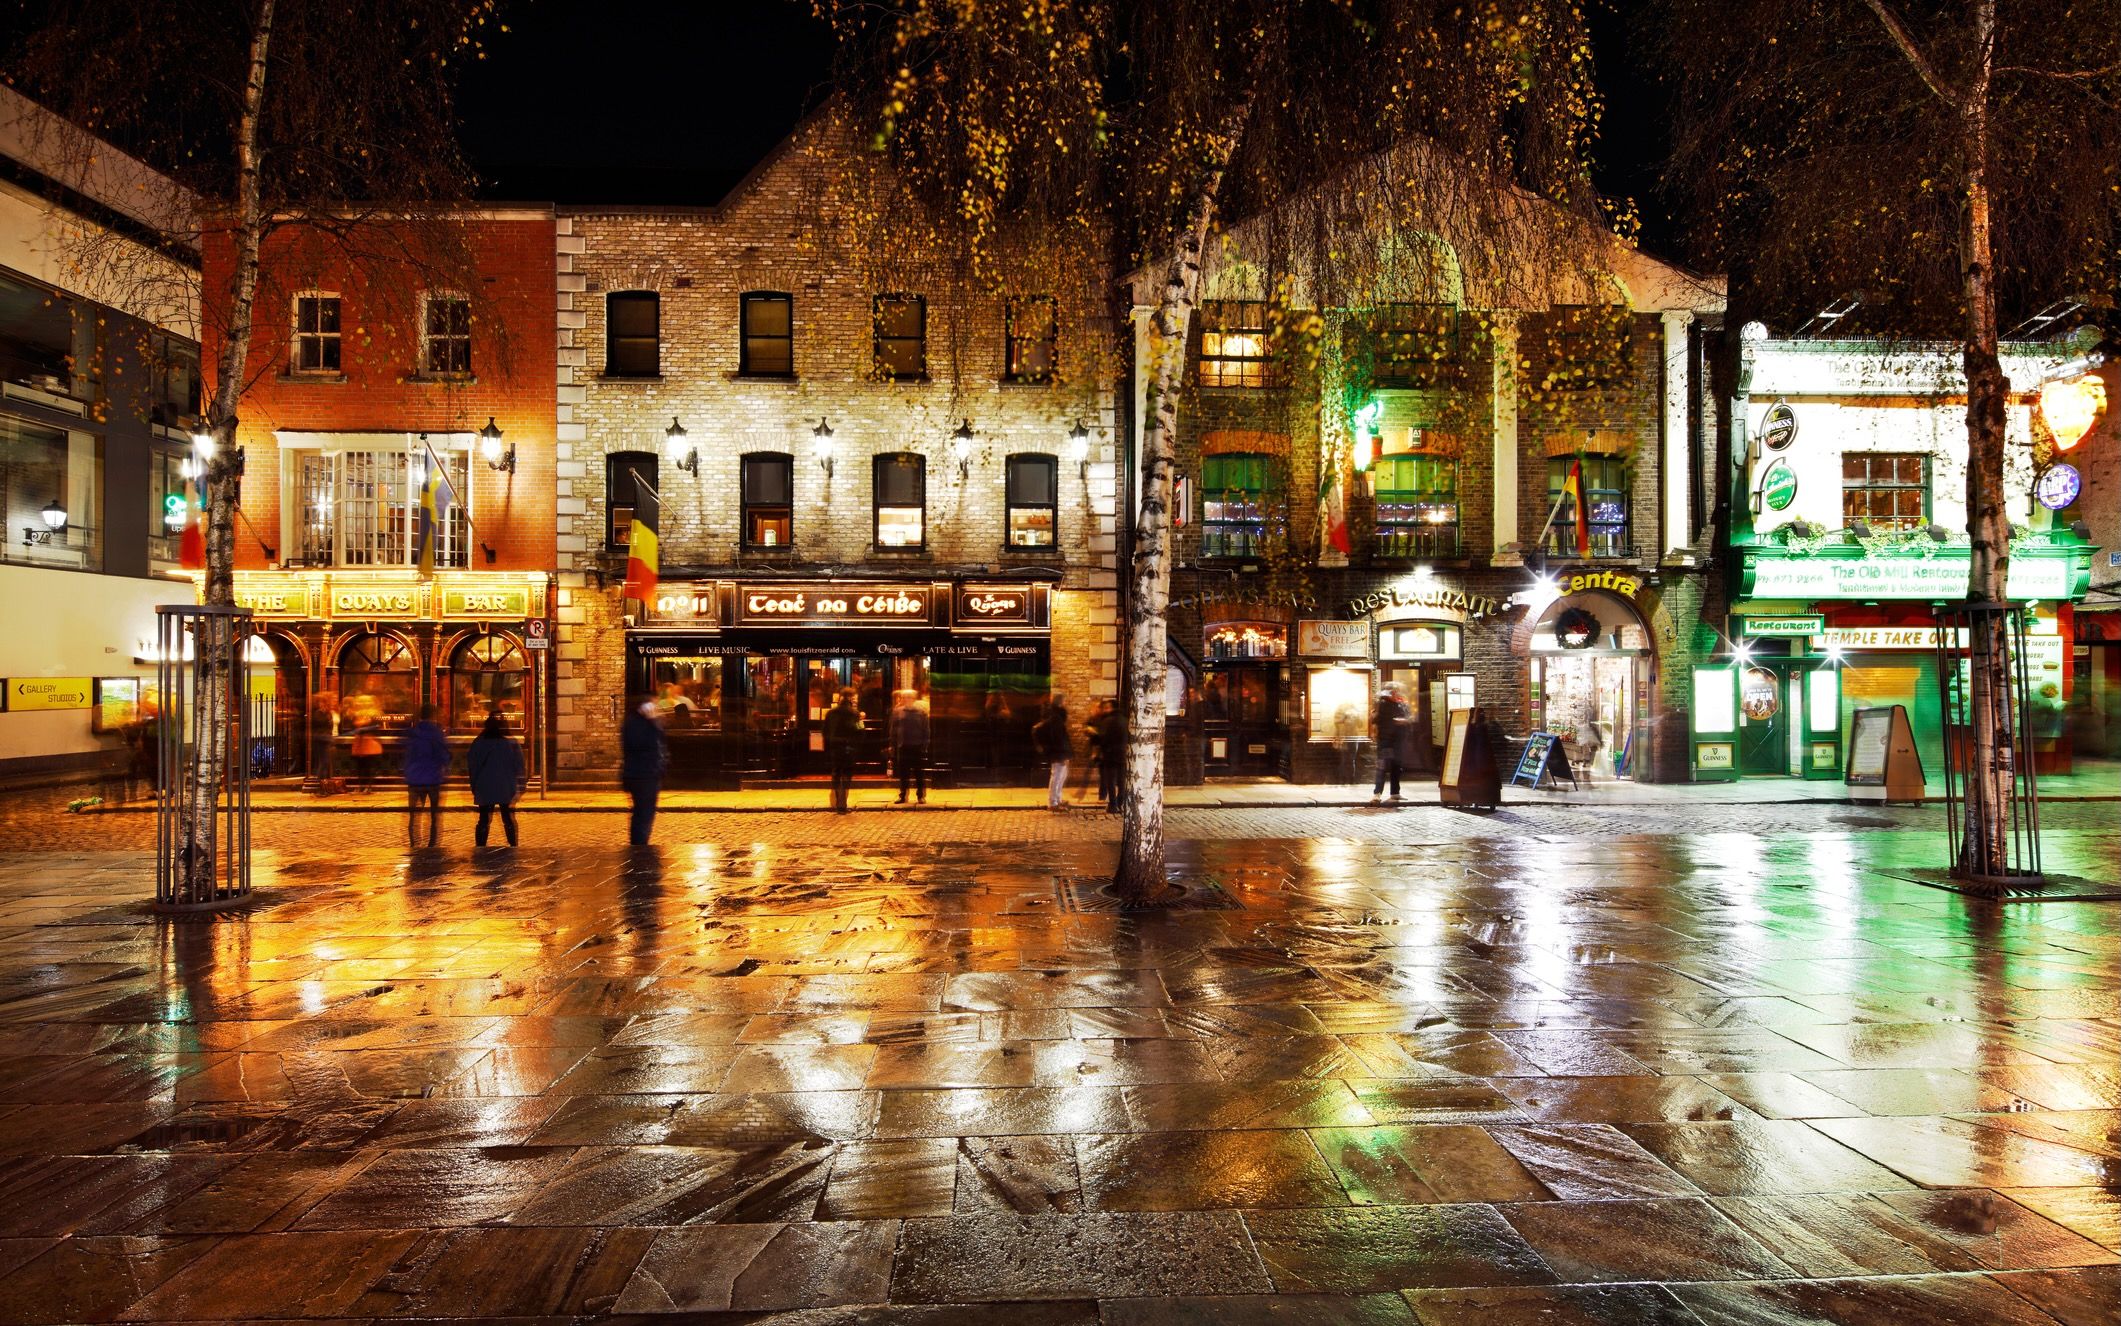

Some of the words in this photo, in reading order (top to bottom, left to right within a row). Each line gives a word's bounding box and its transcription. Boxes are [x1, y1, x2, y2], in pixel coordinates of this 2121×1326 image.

[1830, 565, 1855, 579] The
[1556, 570, 1637, 598] Centra
[243, 594, 287, 611] THE
[463, 594, 507, 611] BAR
[1317, 623, 1347, 637] QUAYS
[1349, 625, 1366, 635] BAR
[1749, 620, 1817, 631] Restaurant
[1330, 636, 1349, 645] FREE
[1823, 632, 1877, 645] TEMPLE
[1885, 632, 1922, 645] TAKE
[646, 646, 679, 654] GUINNESS
[698, 646, 720, 654] LIVE
[721, 646, 750, 654] MUSIC
[922, 645, 946, 654] LATE
[948, 646, 956, 654] &
[957, 646, 979, 654] LIVE
[1005, 646, 1037, 654] GUINNESS
[26, 684, 57, 694] GALLERY
[48, 693, 77, 703] STUDIOS
